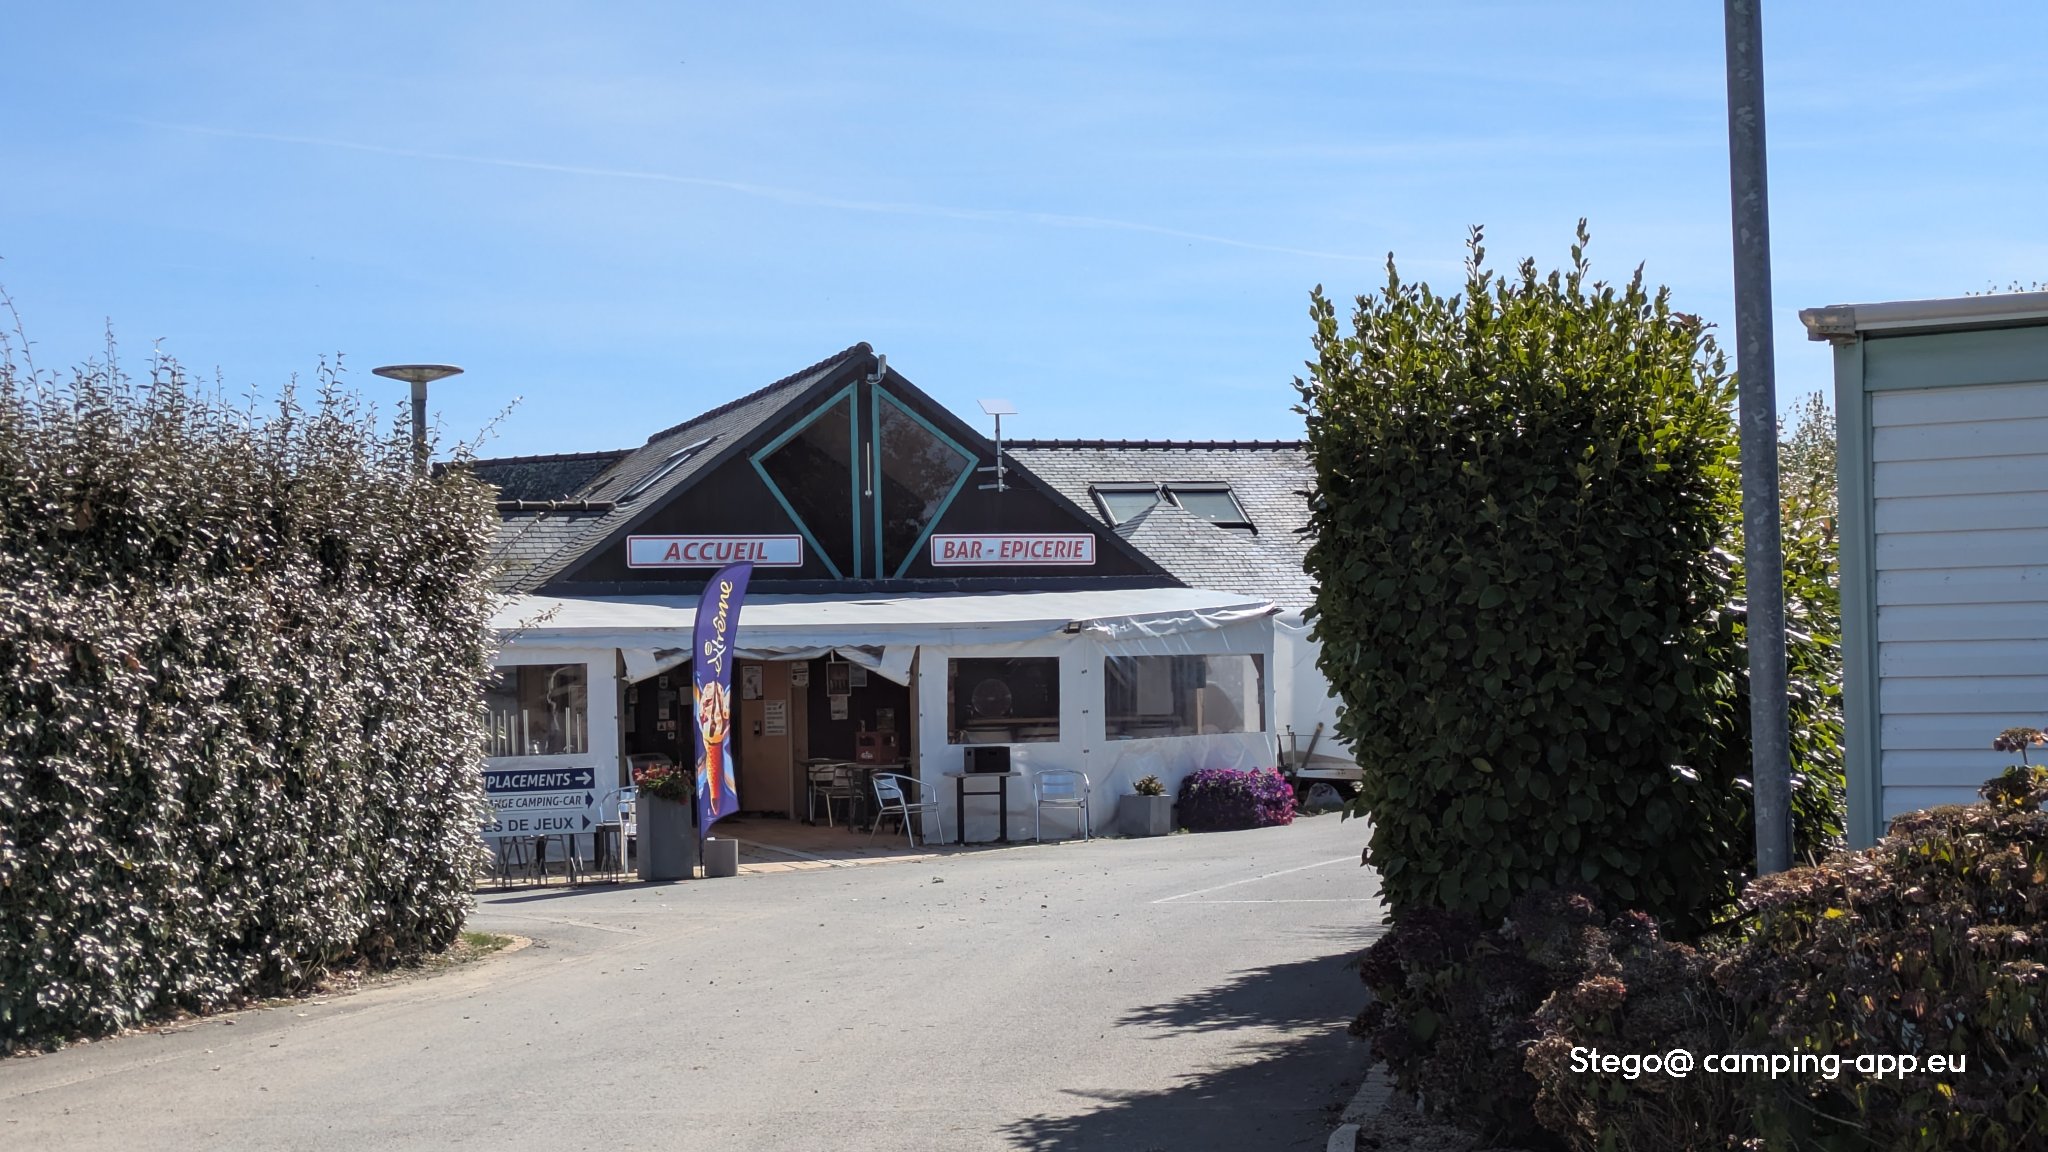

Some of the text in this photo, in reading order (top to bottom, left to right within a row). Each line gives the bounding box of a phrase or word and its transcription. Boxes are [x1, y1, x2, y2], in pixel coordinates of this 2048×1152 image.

[663, 541, 768, 562] ACCUEIL
[943, 541, 982, 559] BAR
[999, 540, 1085, 559] EPICERIE
[483, 772, 571, 789] PLACEMENTS
[485, 795, 582, 810] ANGE CAMPING-CAR
[508, 818, 529, 832] DE
[534, 816, 574, 831] JEUX
